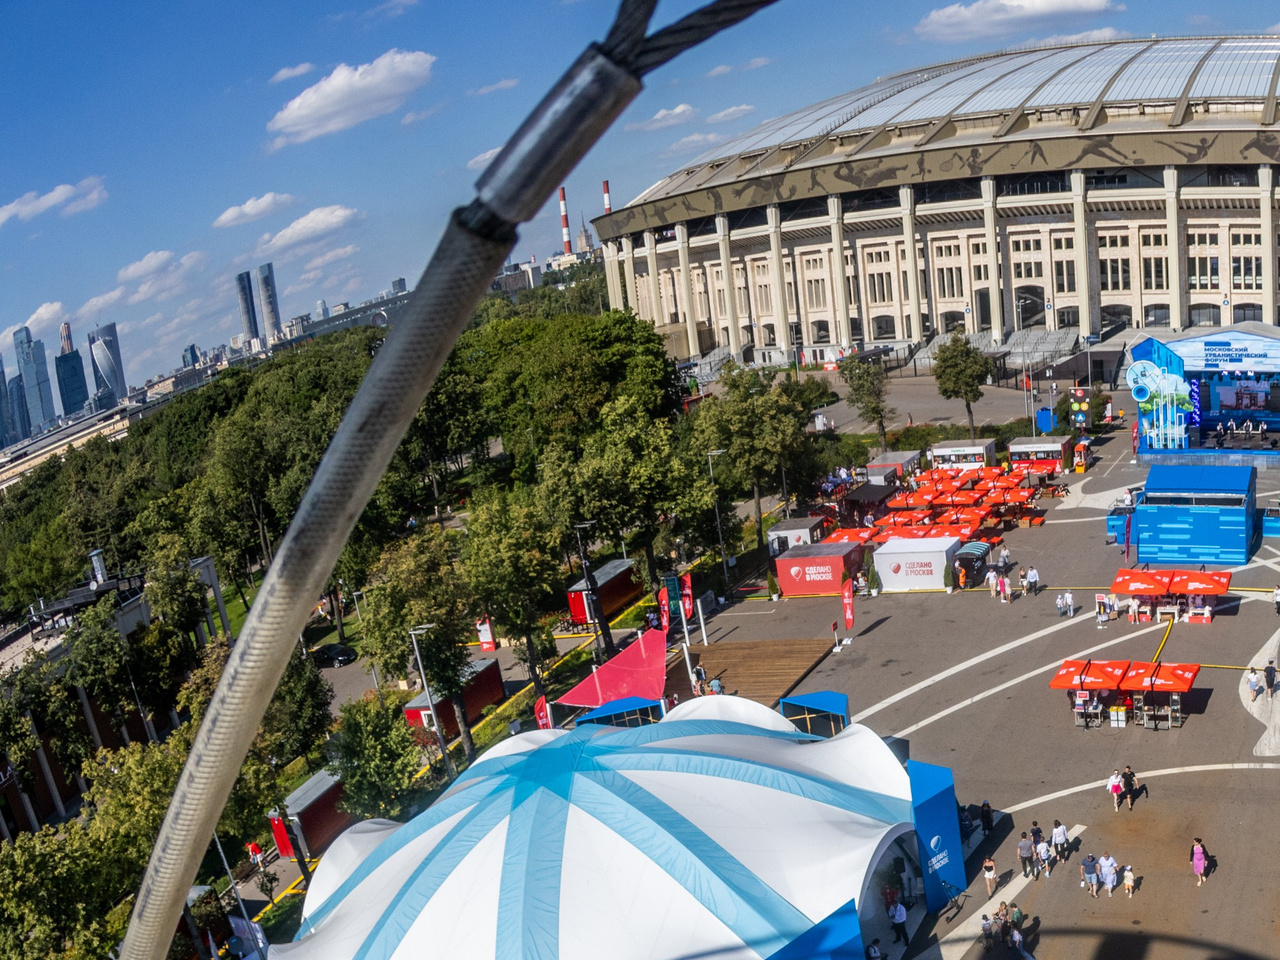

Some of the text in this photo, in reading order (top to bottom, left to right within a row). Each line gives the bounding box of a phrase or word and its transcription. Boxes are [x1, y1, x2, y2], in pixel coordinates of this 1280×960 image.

[805, 566, 832, 574] СДЕЛАНО
[928, 850, 948, 866] СДЕЛАНО
[932, 856, 949, 871] МОСКВЕ
